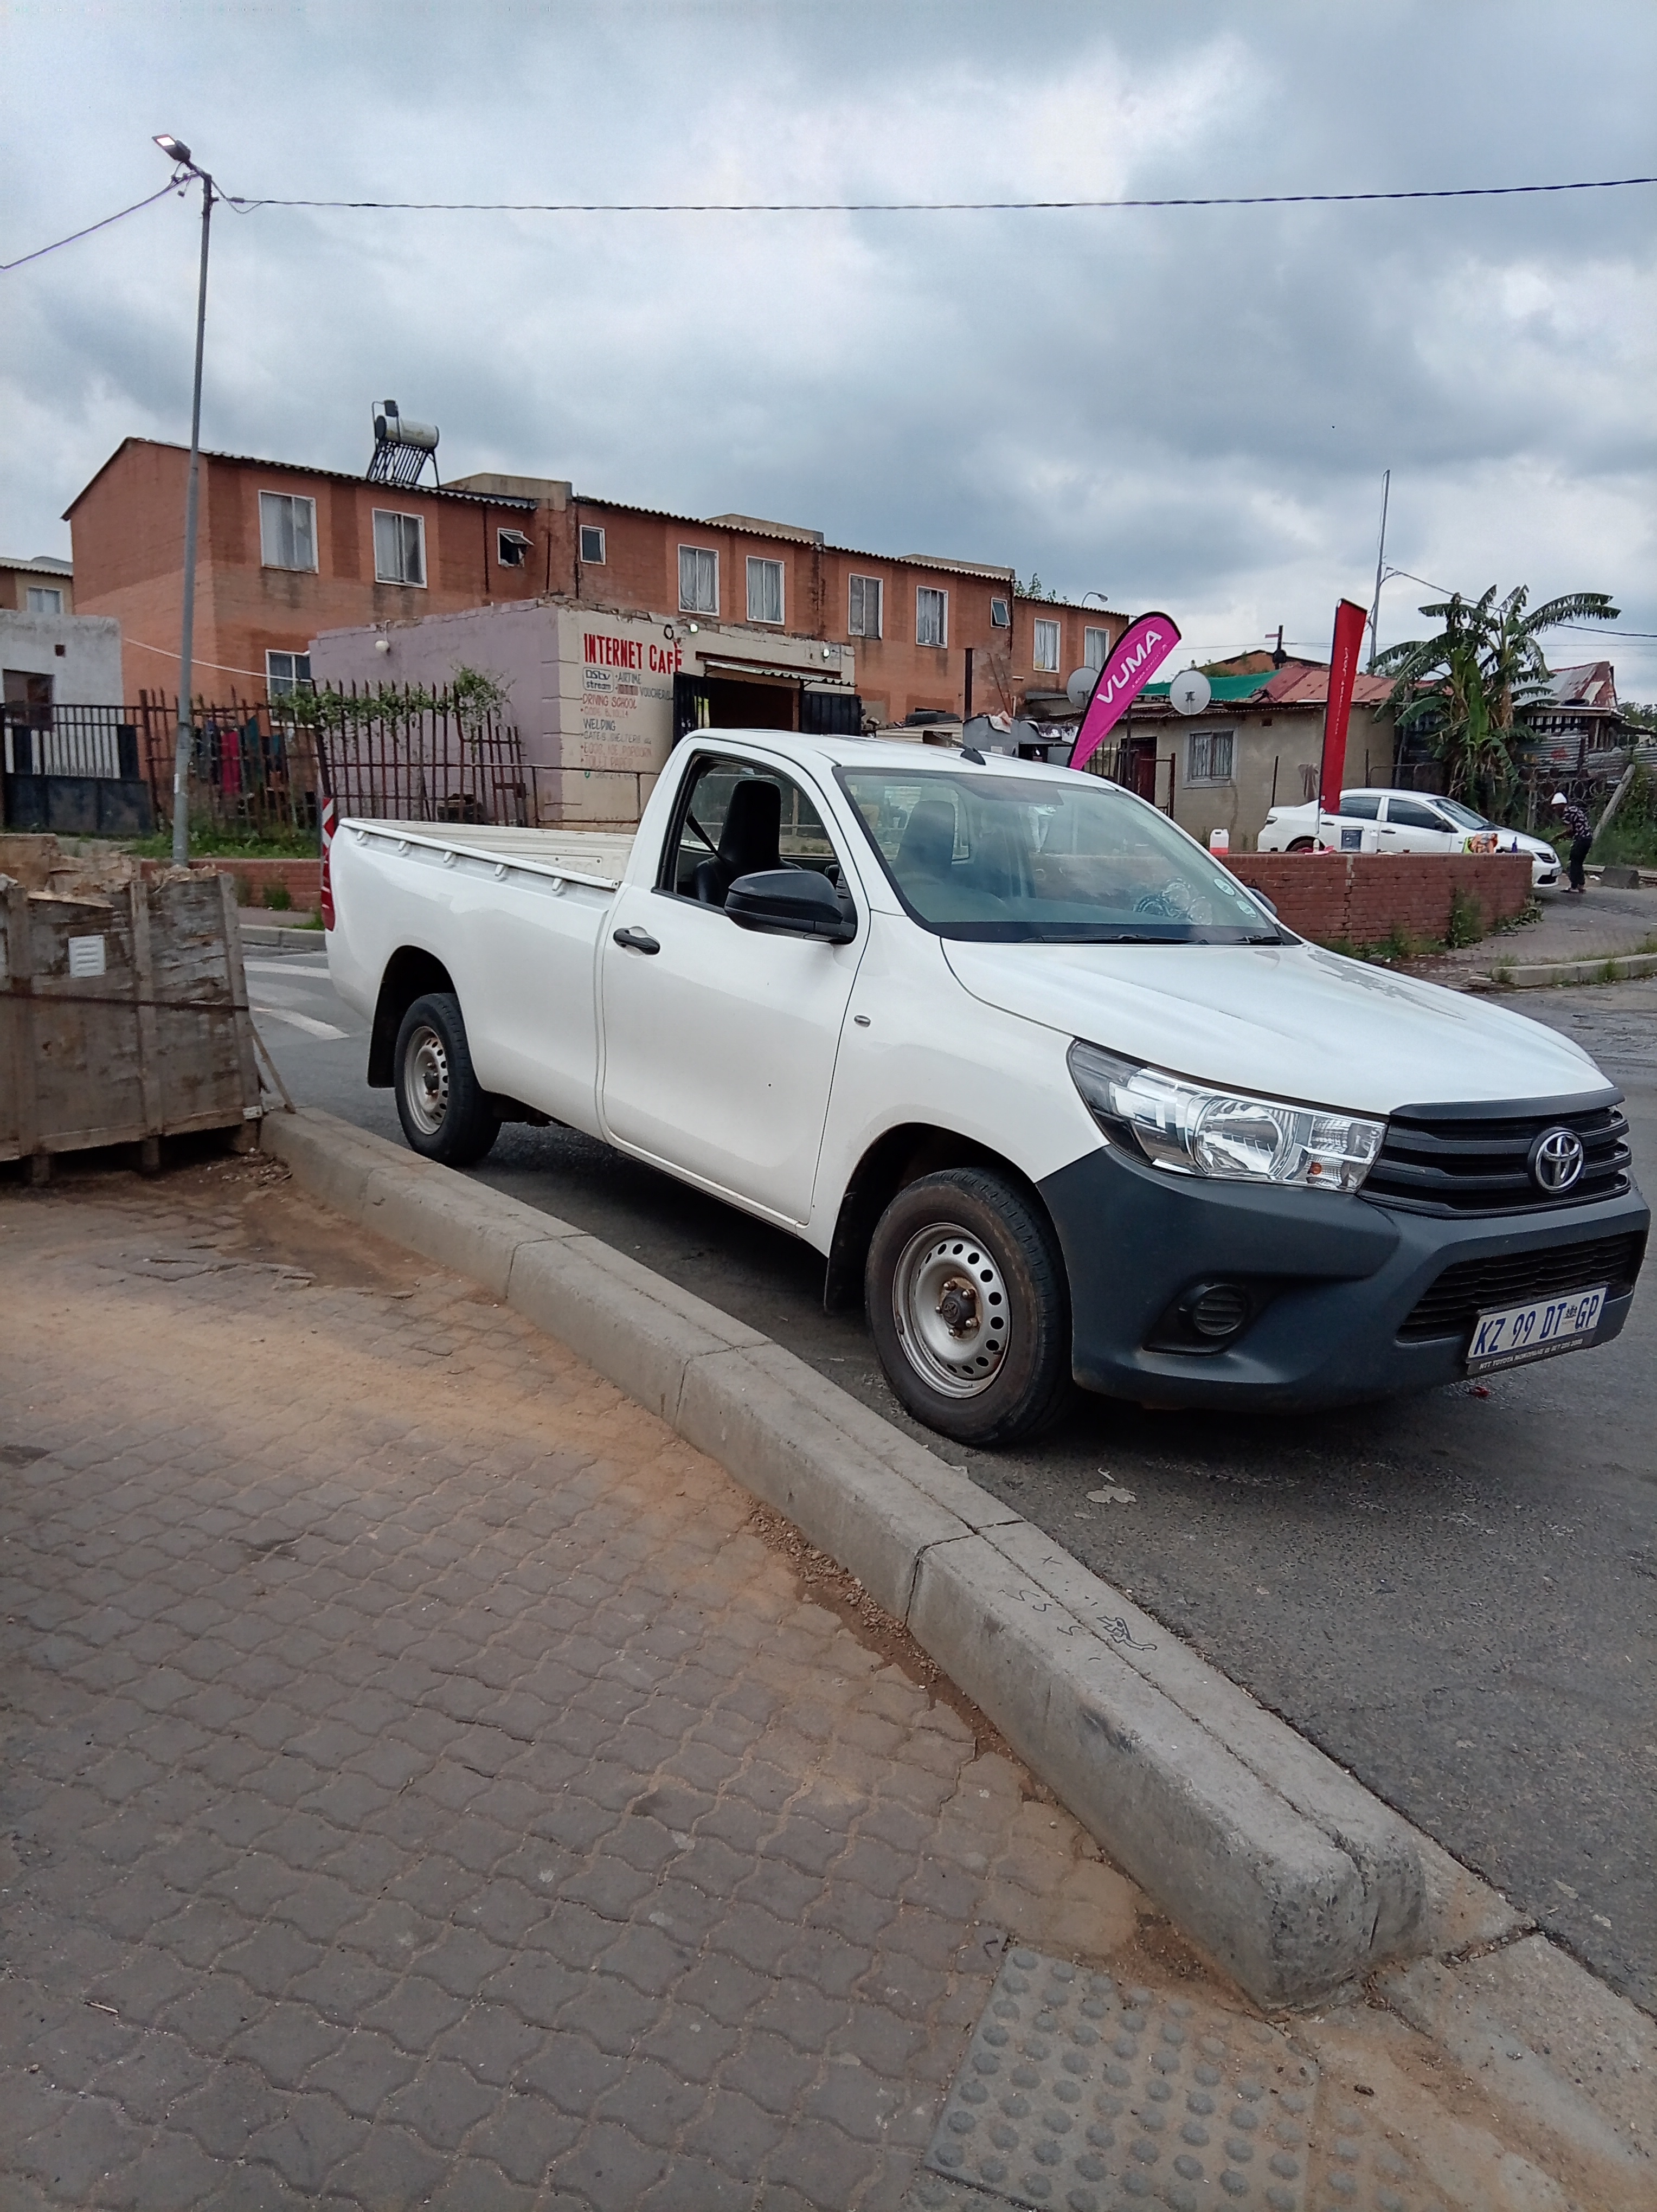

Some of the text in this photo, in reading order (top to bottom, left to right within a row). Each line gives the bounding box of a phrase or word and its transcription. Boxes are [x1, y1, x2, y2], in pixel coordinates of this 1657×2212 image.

[584, 633, 643, 670] INTERNET
[1096, 631, 1163, 703] VUMA
[586, 680, 611, 690] stream
[582, 693, 637, 709] DRIVING SCHOOL
[583, 718, 616, 731] WELDING
[1474, 1317, 1506, 1355] KZ
[1511, 1310, 1536, 1347] 99
[1539, 1302, 1568, 1339] DT
[1575, 1295, 1599, 1329] GP
[1493, 1356, 1513, 1366] TOYOTA
